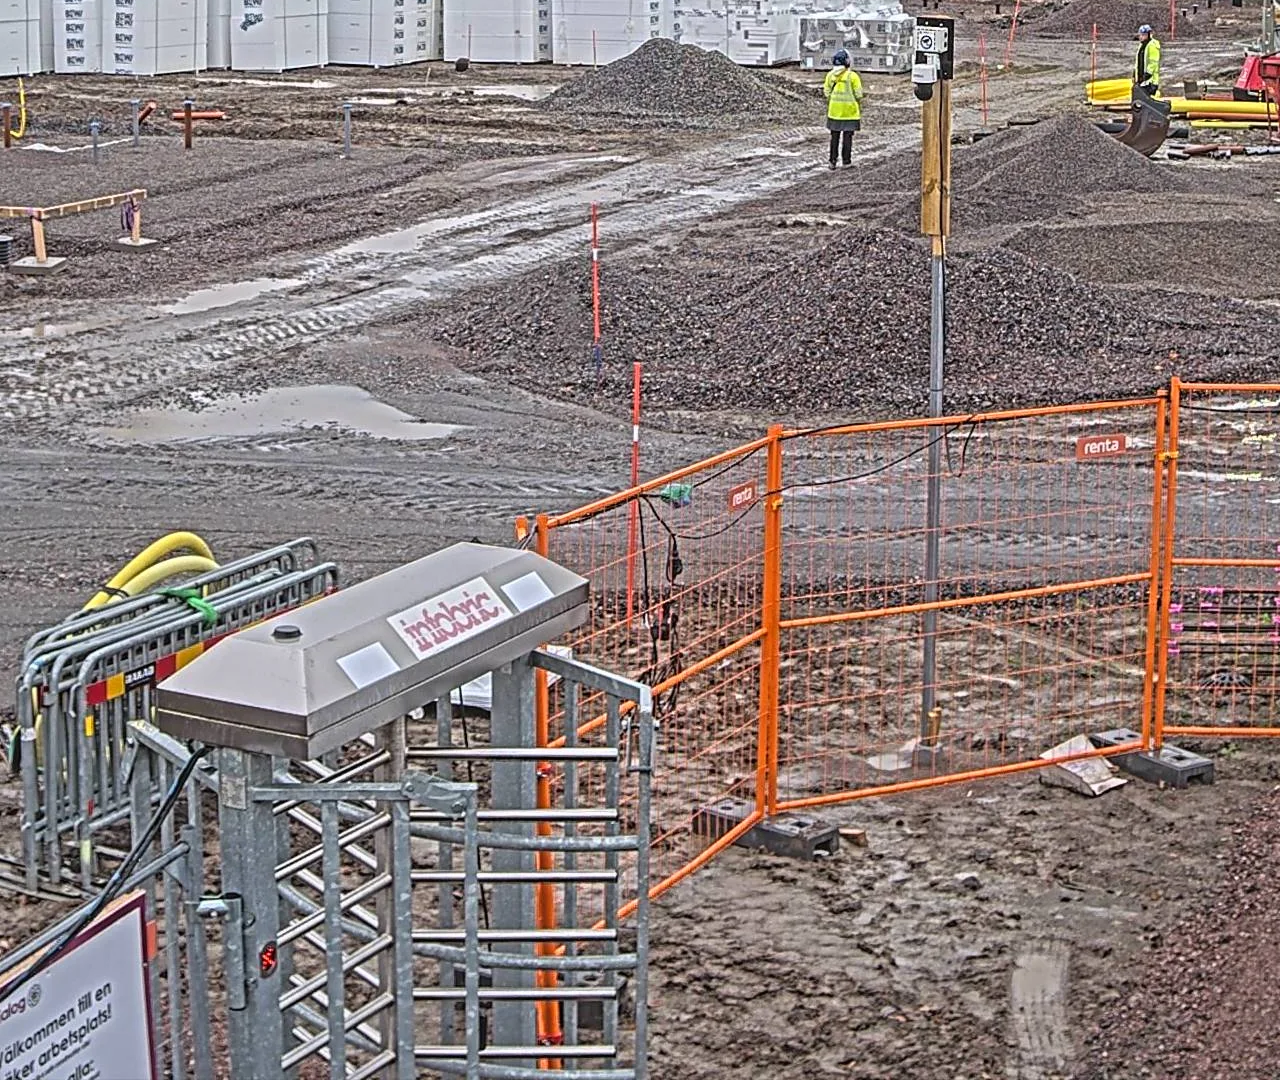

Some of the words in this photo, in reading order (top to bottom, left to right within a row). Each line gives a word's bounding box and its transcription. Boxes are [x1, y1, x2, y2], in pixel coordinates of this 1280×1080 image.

[1084, 439, 1119, 454] renta
[732, 488, 752, 506] renta
[400, 591, 499, 652] infobric
[77, 989, 93, 1015] till
[95, 982, 112, 1002] en
[38, 1003, 112, 1067] arbetsplats!
